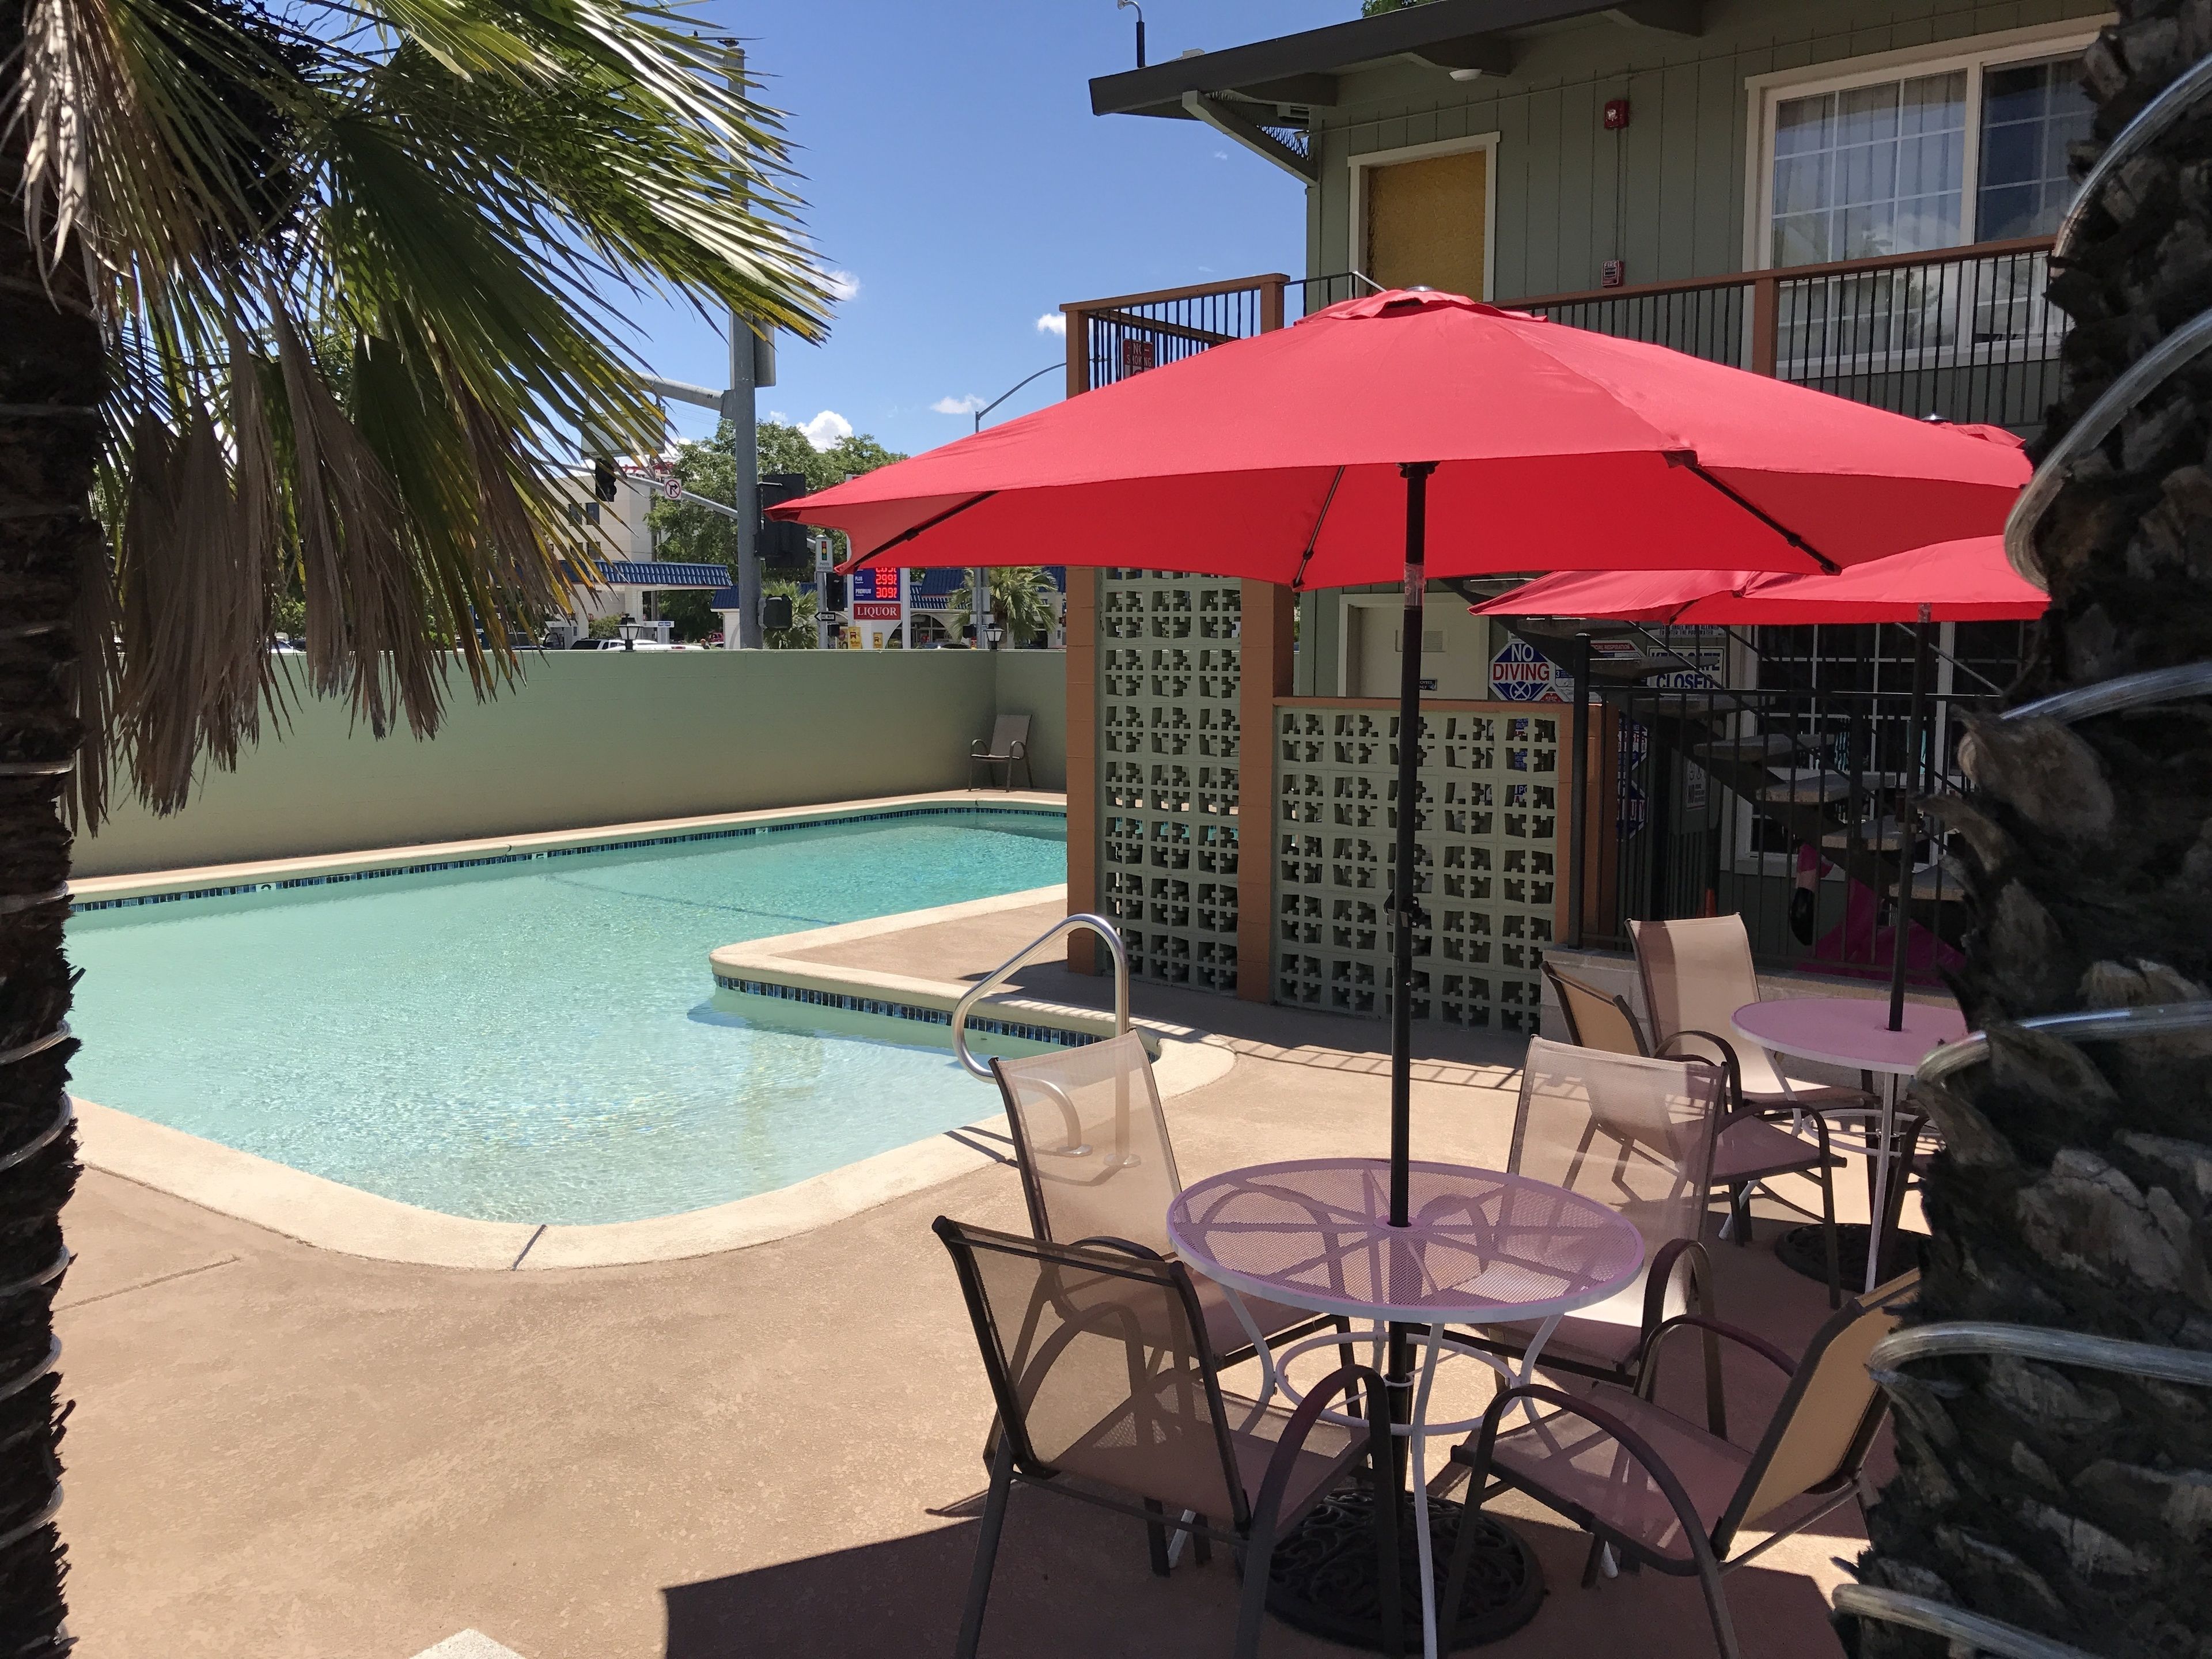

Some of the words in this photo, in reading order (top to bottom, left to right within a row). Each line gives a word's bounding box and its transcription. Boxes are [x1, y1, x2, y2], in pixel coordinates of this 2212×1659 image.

[1126, 354, 1152, 368] SOKNG
[857, 607, 897, 618] LIQUOR
[1511, 643, 1534, 662] NO
[1493, 662, 1550, 681] DIVING
